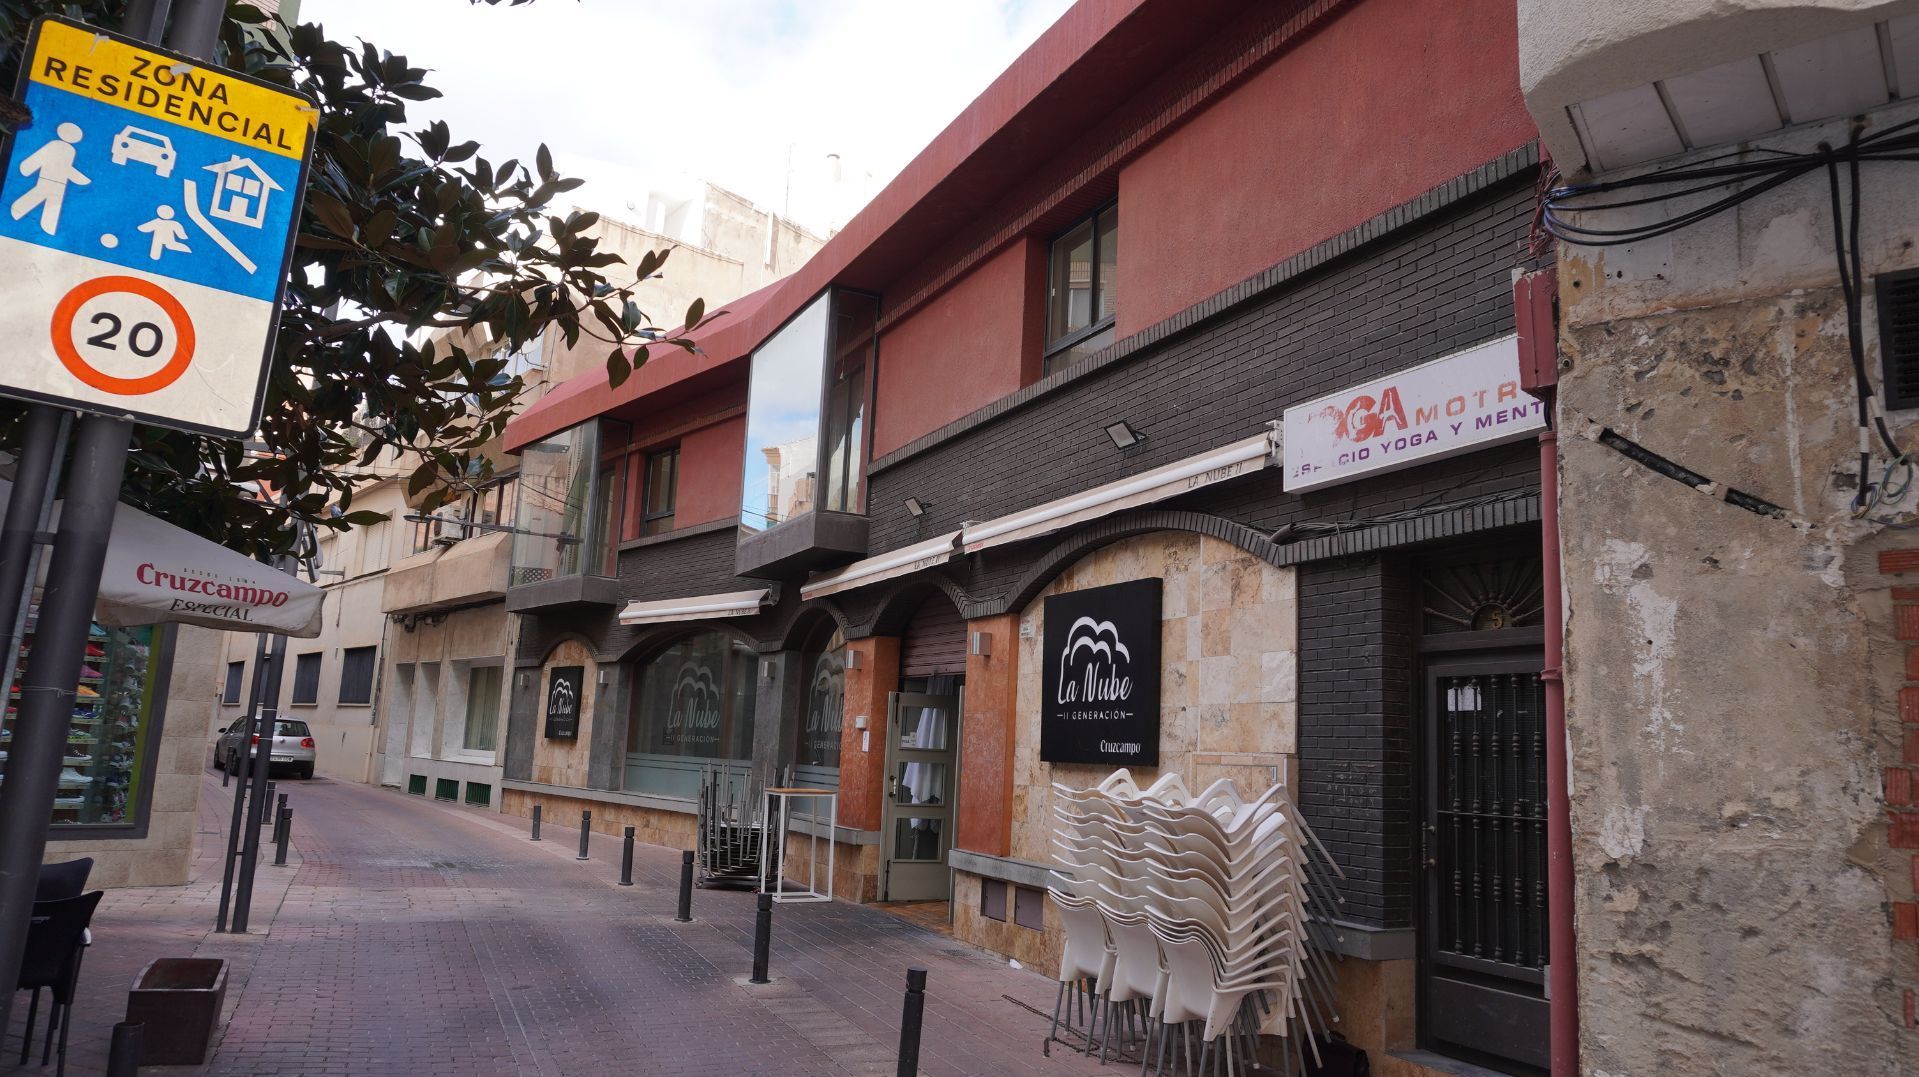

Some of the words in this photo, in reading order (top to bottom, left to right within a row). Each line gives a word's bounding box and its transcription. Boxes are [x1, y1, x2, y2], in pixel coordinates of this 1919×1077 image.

[130, 55, 229, 105] ZONA
[43, 56, 292, 151] RESIDENCIAL
[86, 311, 164, 358] 20
[1380, 430, 1438, 454] YOGA
[1450, 421, 1463, 436] Y
[1187, 476, 1199, 489] LA
[1204, 465, 1233, 484] NUBE
[137, 562, 289, 609] Cruzcampo
[168, 598, 254, 622] ESPECIAL
[1057, 658, 1080, 705] La
[1082, 661, 1134, 703] Nube
[667, 696, 682, 729] La
[685, 697, 720, 729] Nube
[1100, 739, 1141, 756] Cruzcampo
